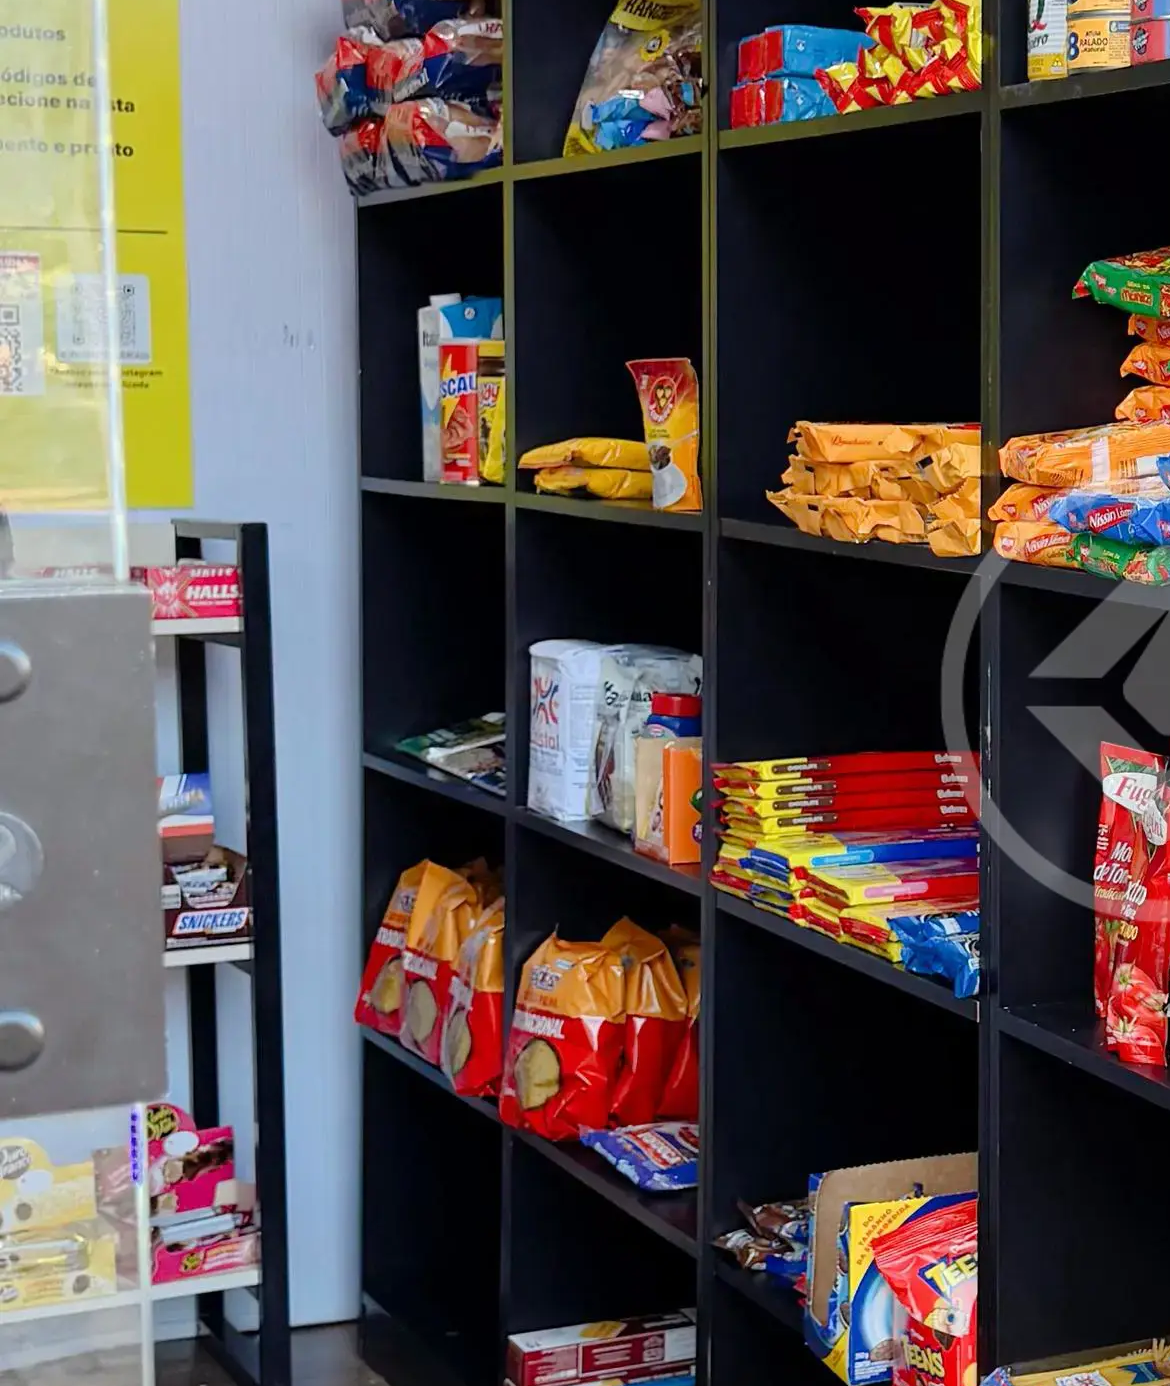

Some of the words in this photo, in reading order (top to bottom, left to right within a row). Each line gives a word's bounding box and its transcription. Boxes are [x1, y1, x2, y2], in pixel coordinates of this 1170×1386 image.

[1090, 509, 1117, 530] Nissin
[184, 583, 242, 603] HALLS
[177, 907, 248, 933] SNICKERS
[903, 1334, 946, 1379] TEENS
